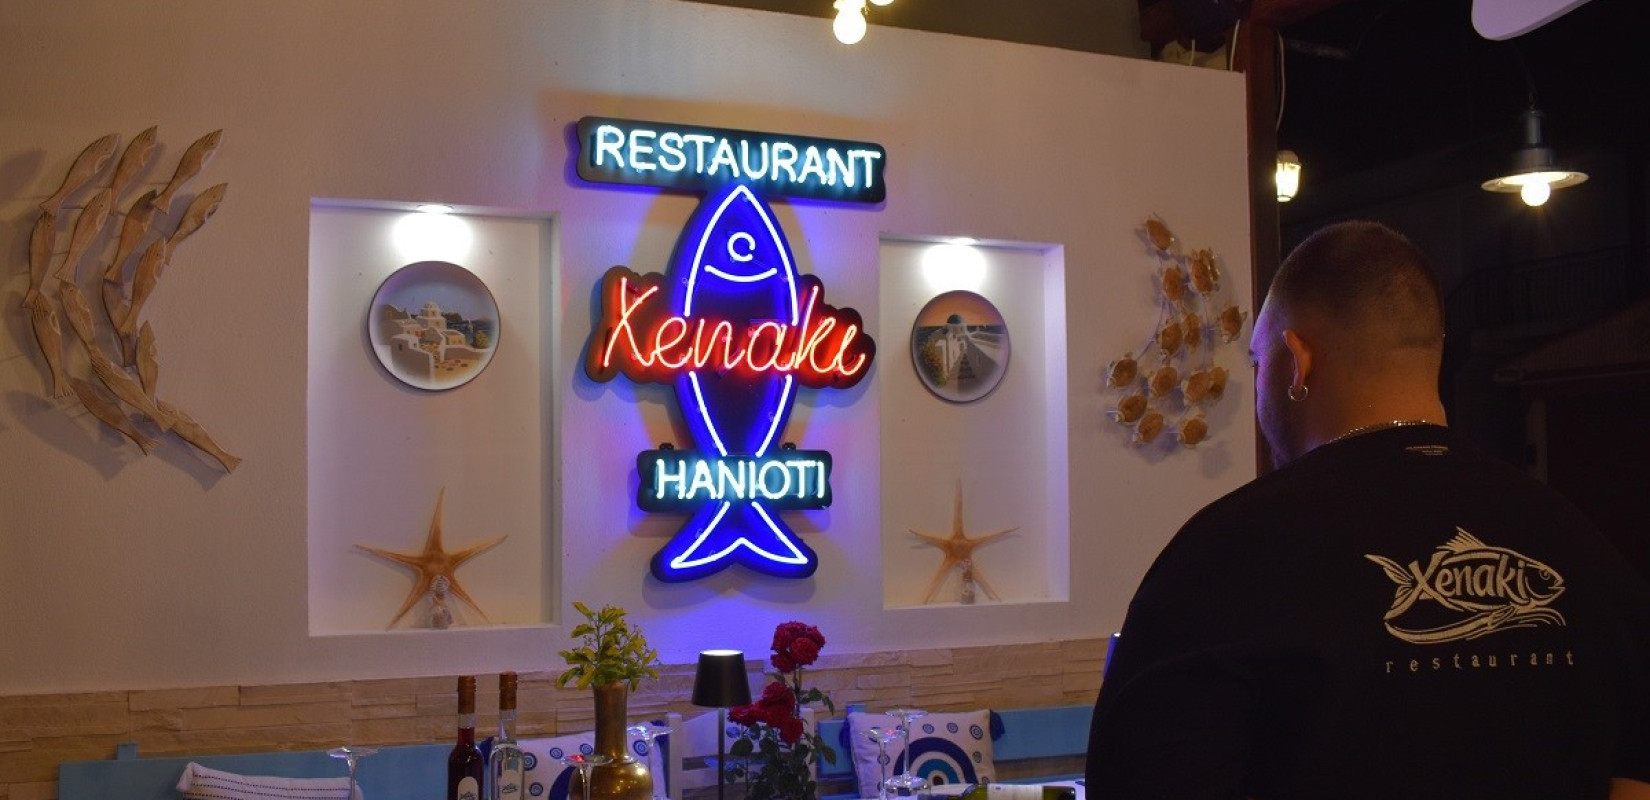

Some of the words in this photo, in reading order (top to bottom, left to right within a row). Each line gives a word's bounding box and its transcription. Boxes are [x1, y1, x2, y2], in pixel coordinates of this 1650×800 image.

[595, 124, 882, 188] RESTAURANT
[603, 276, 866, 376] Xenaki
[655, 458, 826, 500] HANIOTI
[1385, 550, 1529, 617] Xenaki
[1385, 651, 1574, 673] restaurant
